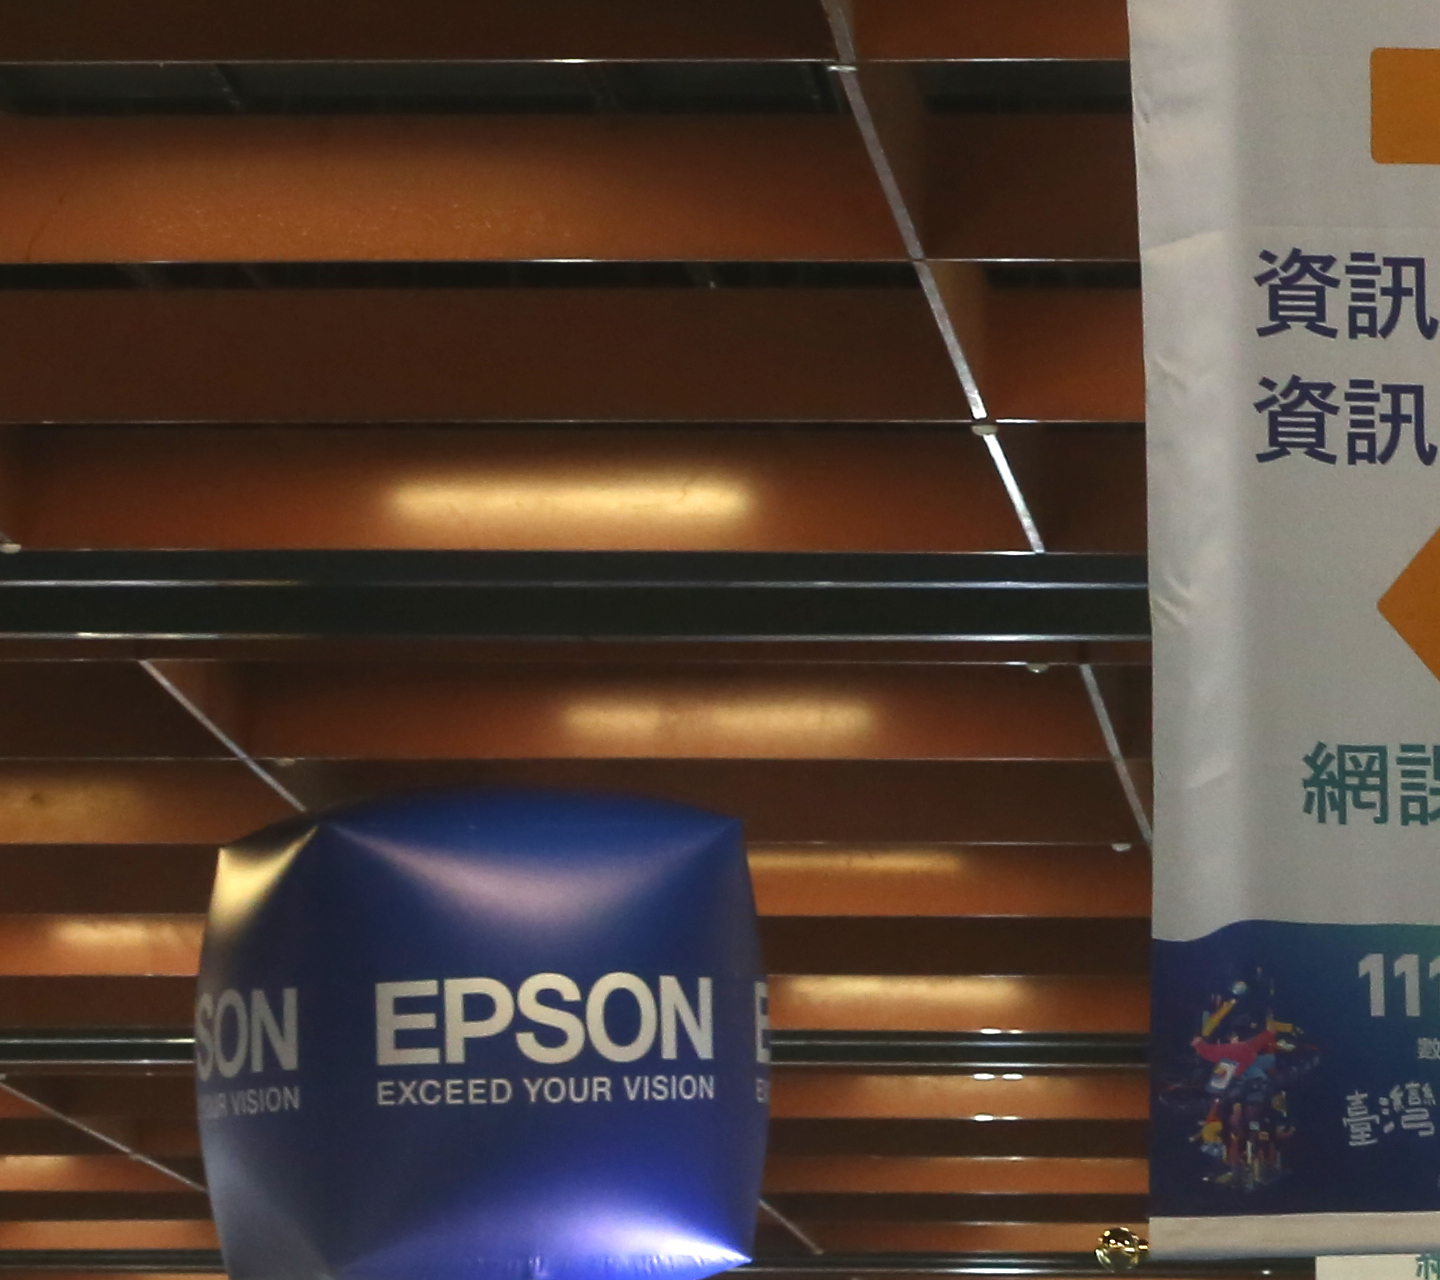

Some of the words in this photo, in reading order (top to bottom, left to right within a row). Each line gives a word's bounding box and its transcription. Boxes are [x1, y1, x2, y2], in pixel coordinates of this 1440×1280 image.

[195, 987, 297, 1081] SON
[374, 971, 715, 1065] EPSON
[377, 1079, 512, 1106] EXCEED
[523, 1077, 612, 1104] YOUR
[623, 1074, 715, 1101] VISION
